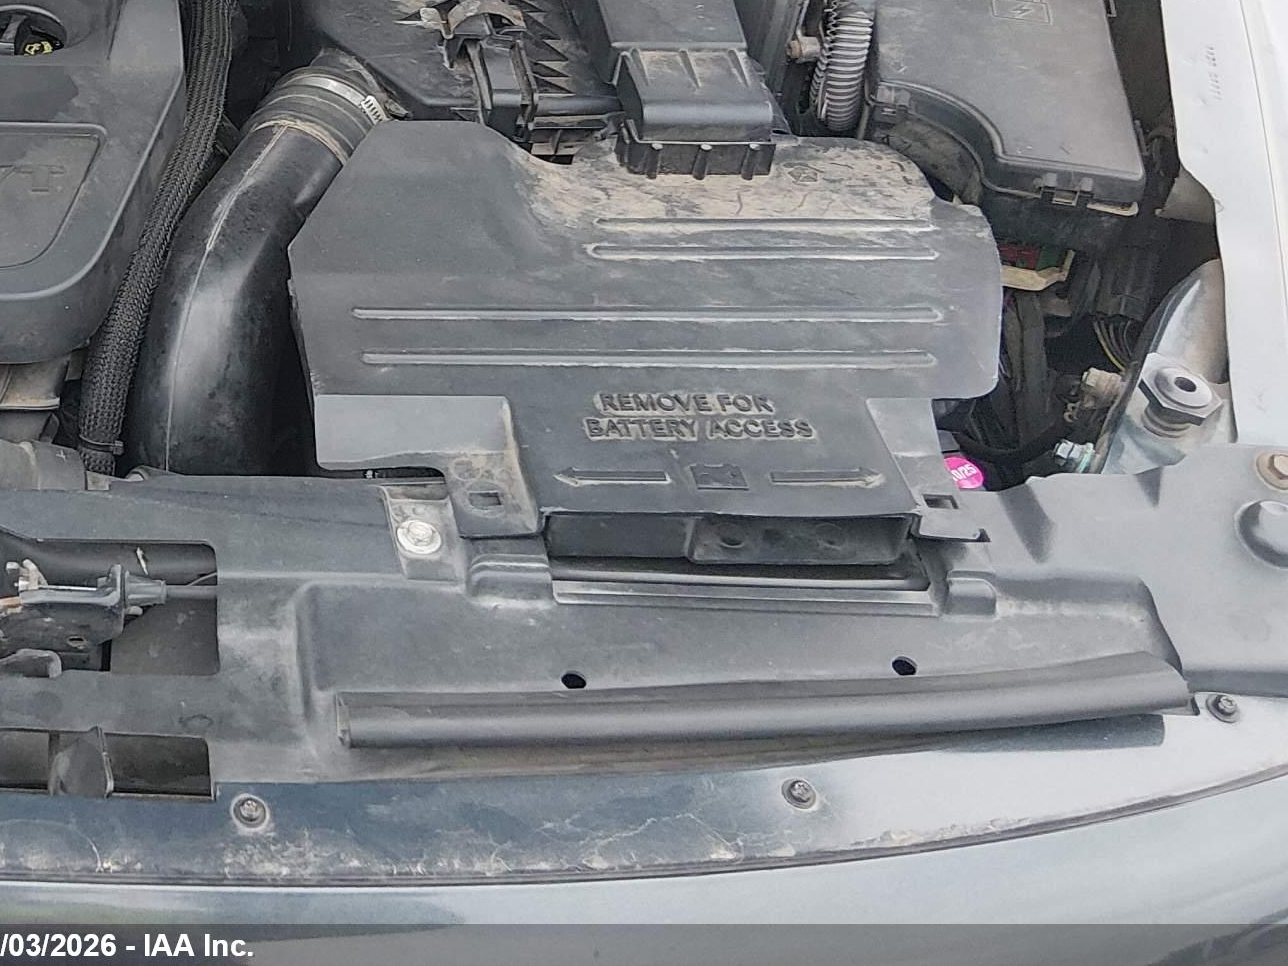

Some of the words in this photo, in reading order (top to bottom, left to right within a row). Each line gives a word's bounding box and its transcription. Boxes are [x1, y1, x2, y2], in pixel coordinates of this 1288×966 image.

[600, 393, 711, 413] REMOVE
[717, 393, 775, 415] FOR
[585, 418, 699, 440] BATTERY
[709, 418, 814, 439] ACCESS
